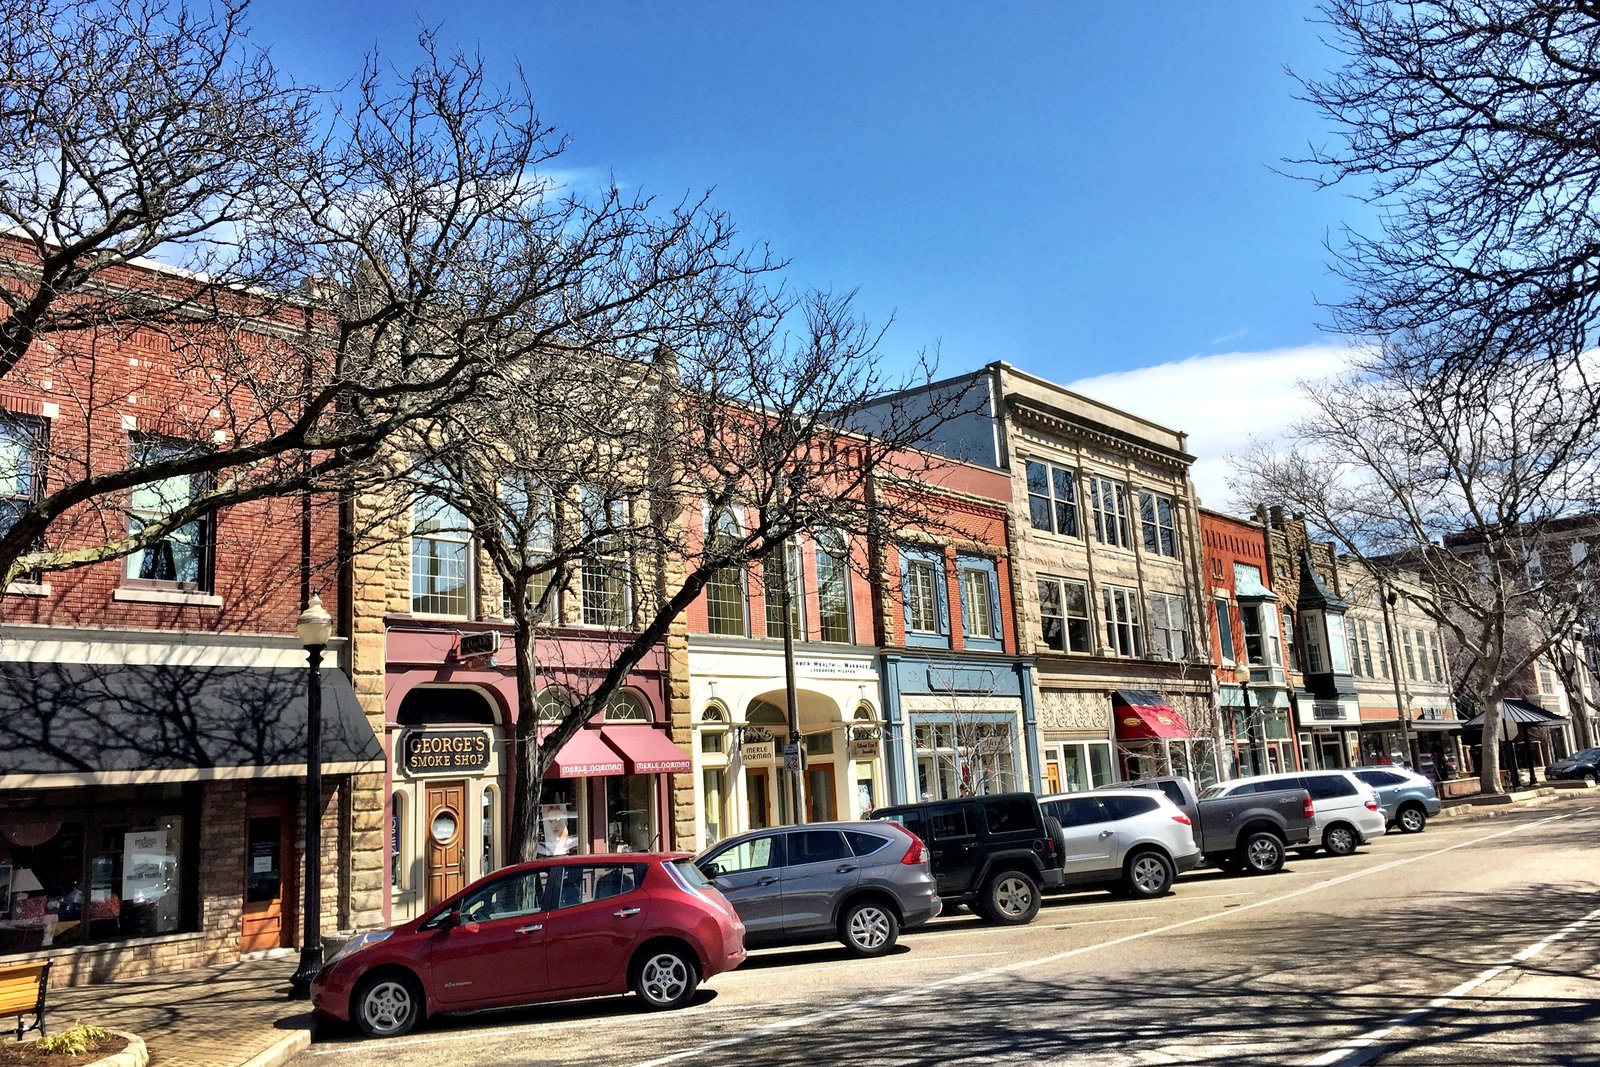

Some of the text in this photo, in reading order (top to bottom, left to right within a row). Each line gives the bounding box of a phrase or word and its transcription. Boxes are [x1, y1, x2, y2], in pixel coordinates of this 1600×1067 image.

[410, 736, 485, 754] GEORGE'S
[746, 746, 768, 754] MERLE
[411, 754, 484, 767] SMOKE SHOP
[743, 752, 772, 761] NORMAN
[590, 763, 622, 771] NORMAN
